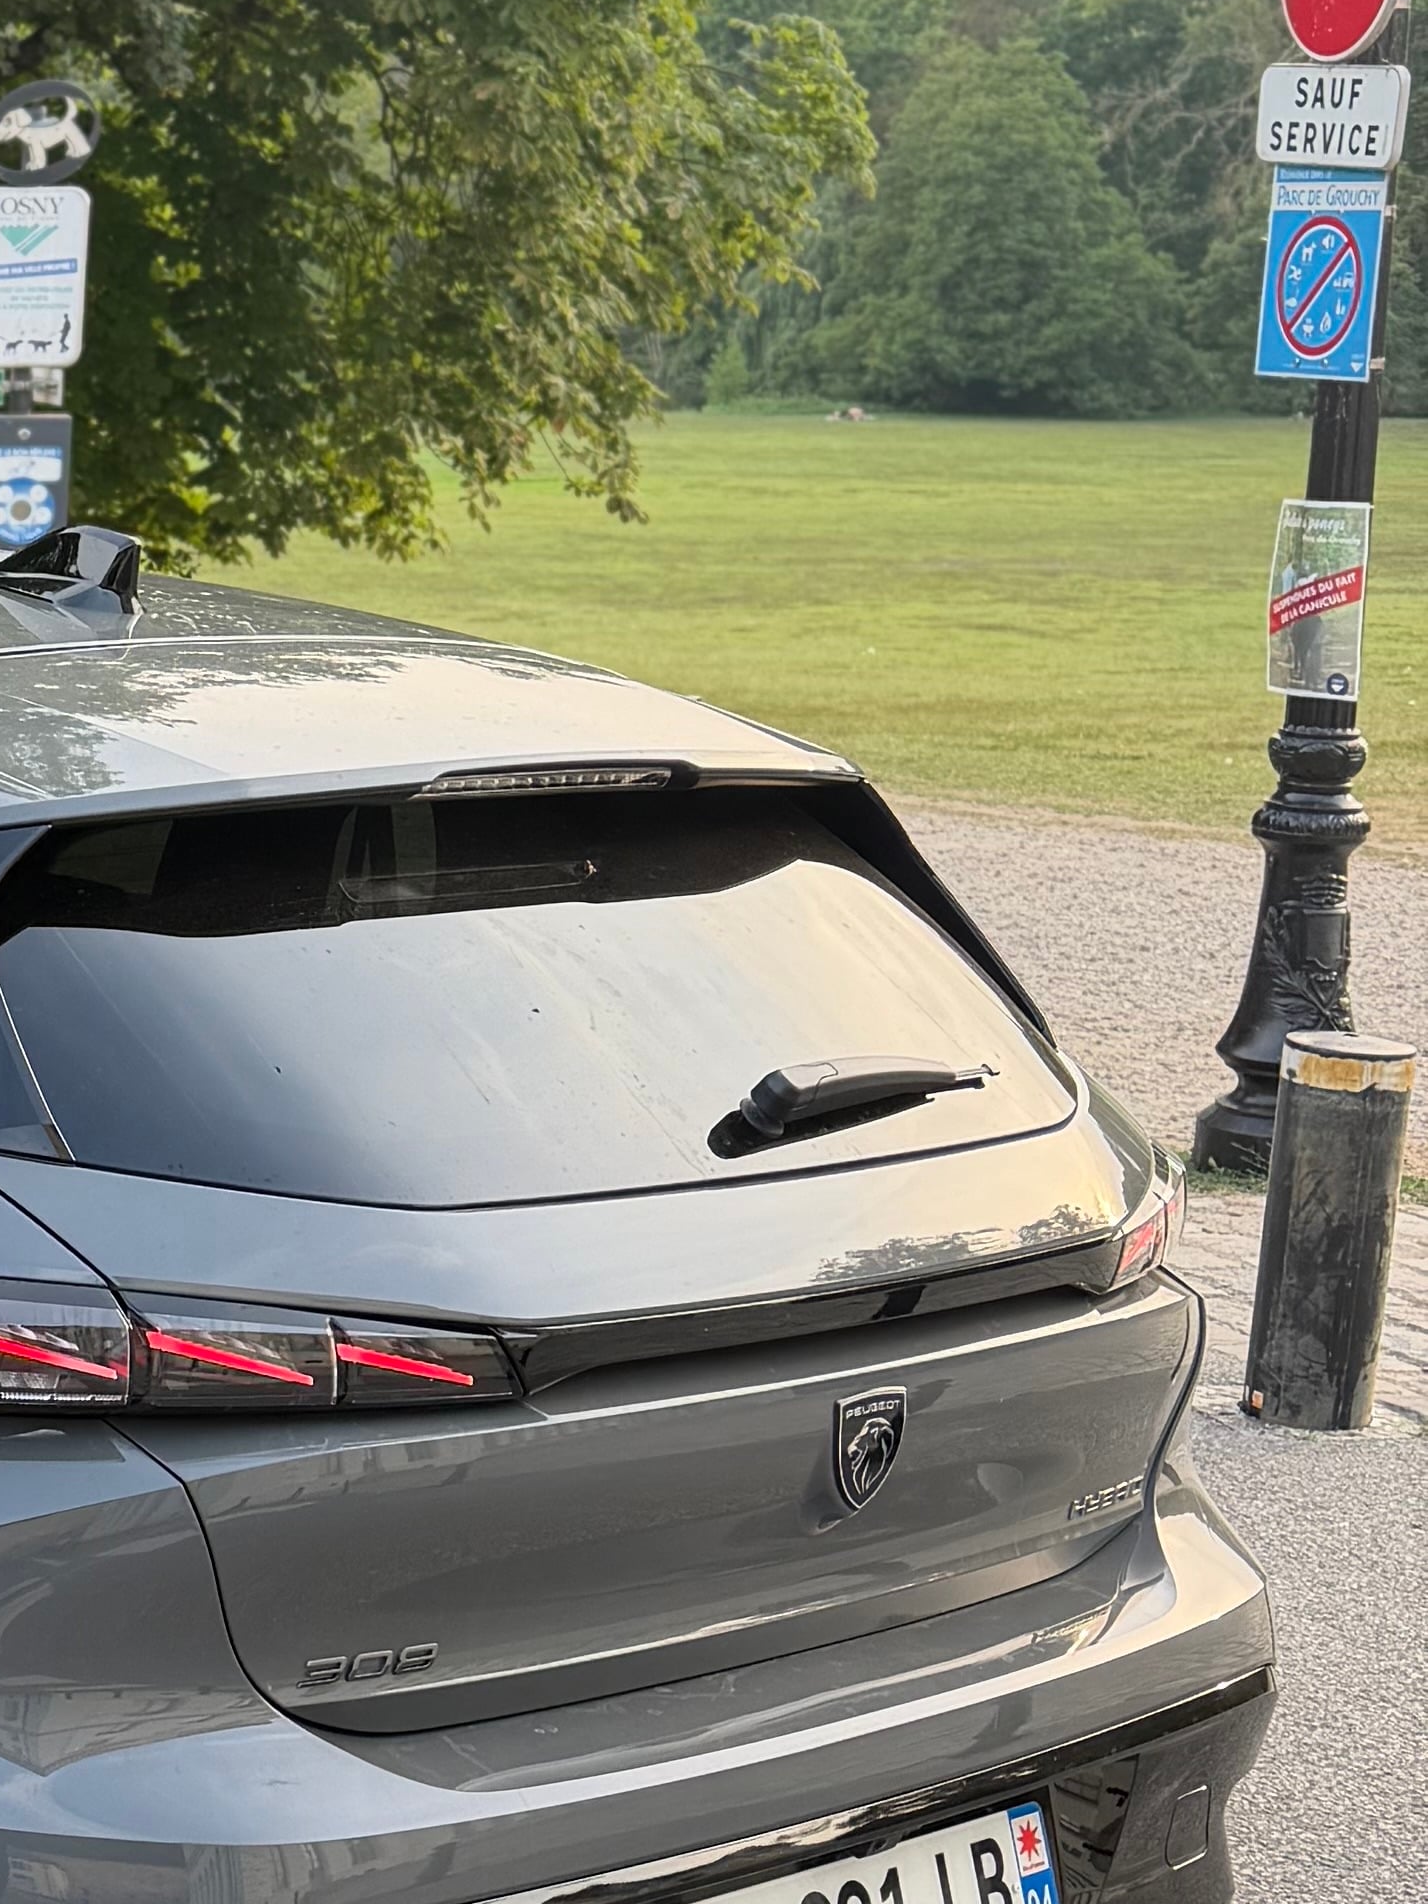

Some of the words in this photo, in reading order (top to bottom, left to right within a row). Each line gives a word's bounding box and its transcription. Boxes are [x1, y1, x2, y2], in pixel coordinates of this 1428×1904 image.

[1295, 77, 1363, 110] SAUF
[1269, 121, 1380, 156] SERVICE
[0, 196, 65, 215] OSNY
[1277, 184, 1304, 206] PARC
[1307, 189, 1322, 206] DE
[1317, 579, 1334, 594] DU
[1335, 571, 1357, 589] FAIT
[1298, 590, 1348, 615] CANICULE
[846, 1399, 901, 1420] PEUGEOT
[296, 1642, 439, 1689] 308
